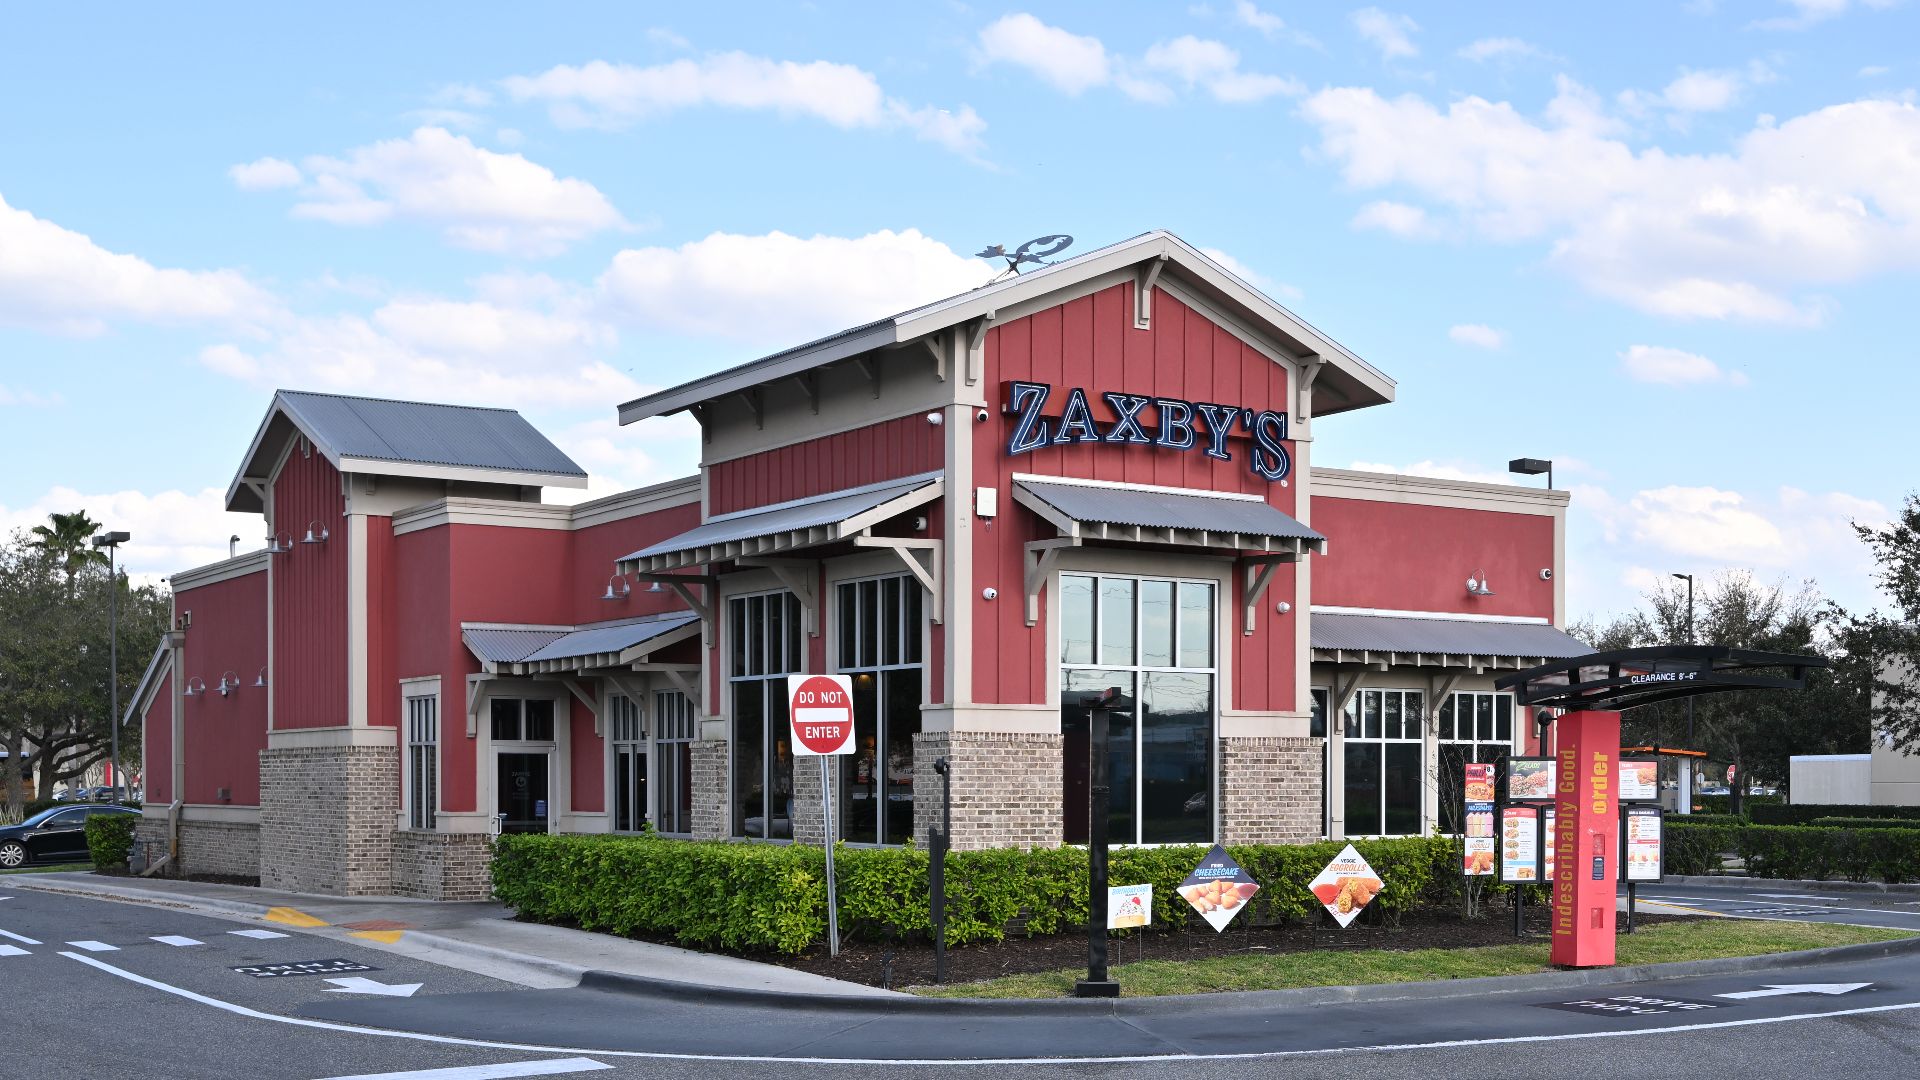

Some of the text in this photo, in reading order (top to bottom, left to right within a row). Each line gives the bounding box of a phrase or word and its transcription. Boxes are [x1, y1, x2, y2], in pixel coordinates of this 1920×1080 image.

[1008, 381, 1290, 481] ZAXBY'S
[1631, 673, 1676, 683] CLEARANCE
[799, 691, 842, 704] DO NOT
[805, 726, 840, 739] ENTER
[1591, 751, 1608, 814] order
[1556, 744, 1578, 935] Indescribably Good.
[1194, 867, 1239, 877] CHEESECAKE
